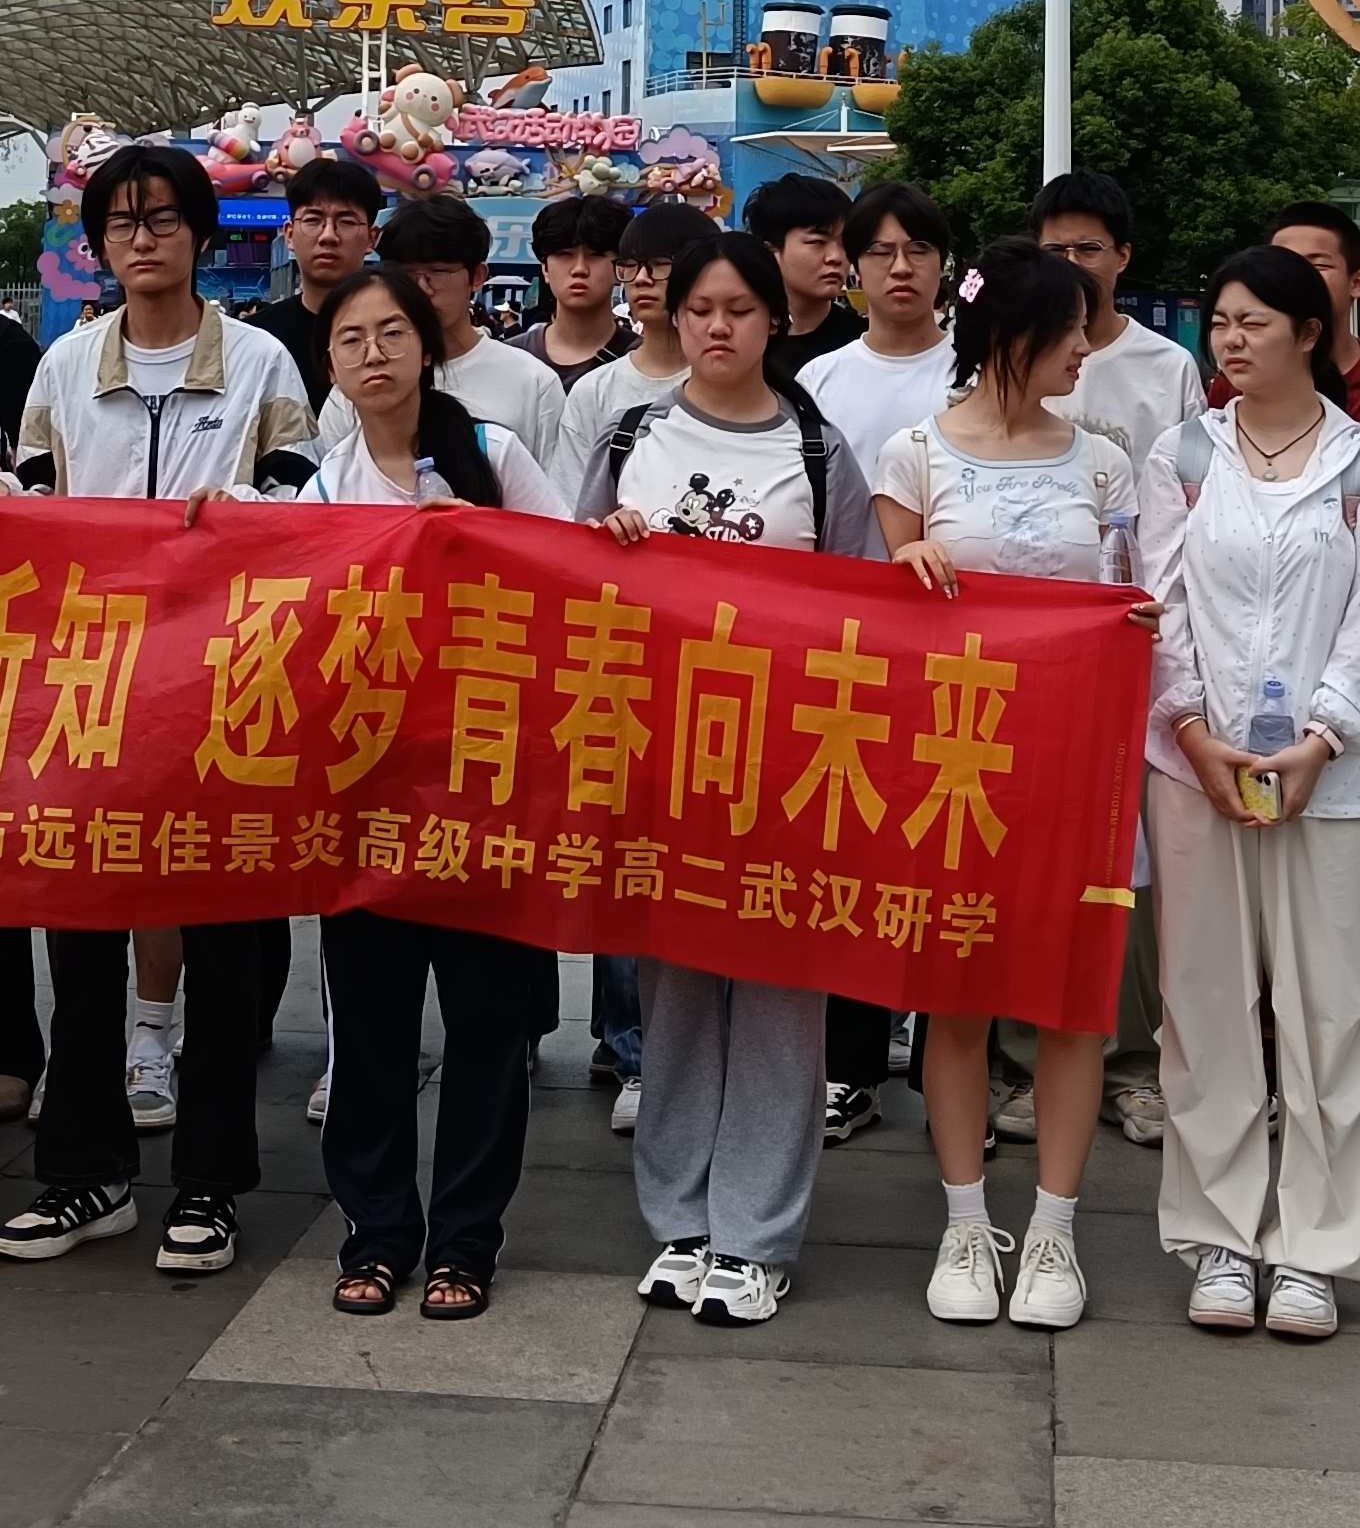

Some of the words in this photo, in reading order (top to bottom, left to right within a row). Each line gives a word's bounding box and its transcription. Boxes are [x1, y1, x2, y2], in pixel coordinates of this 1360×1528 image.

[194, 565, 1019, 871] 逐梦青春向未来
